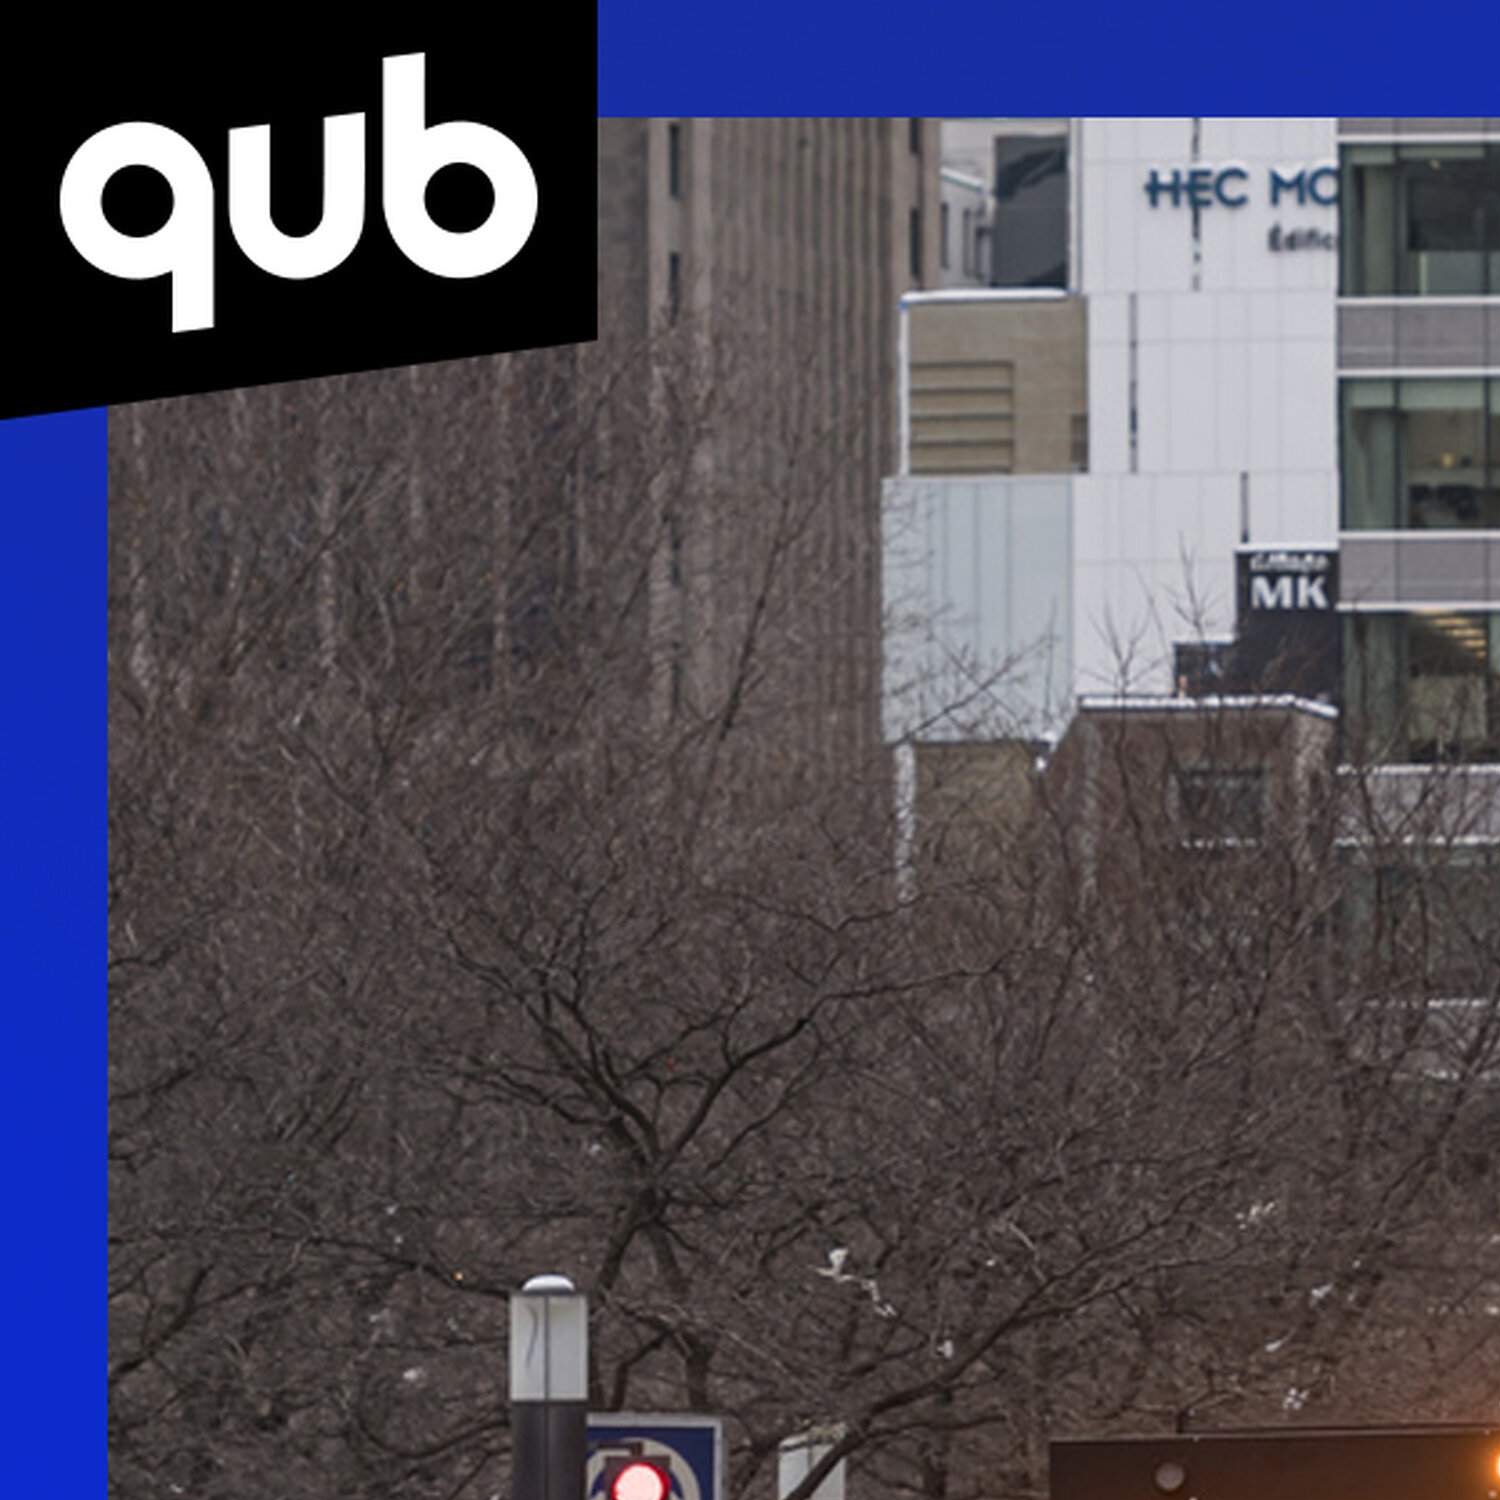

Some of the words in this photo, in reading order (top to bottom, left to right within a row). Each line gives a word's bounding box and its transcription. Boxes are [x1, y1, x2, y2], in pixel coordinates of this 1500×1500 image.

[1144, 166, 1250, 208] HEC
[1269, 166, 1339, 207] MO
[1251, 575, 1330, 610] MK
